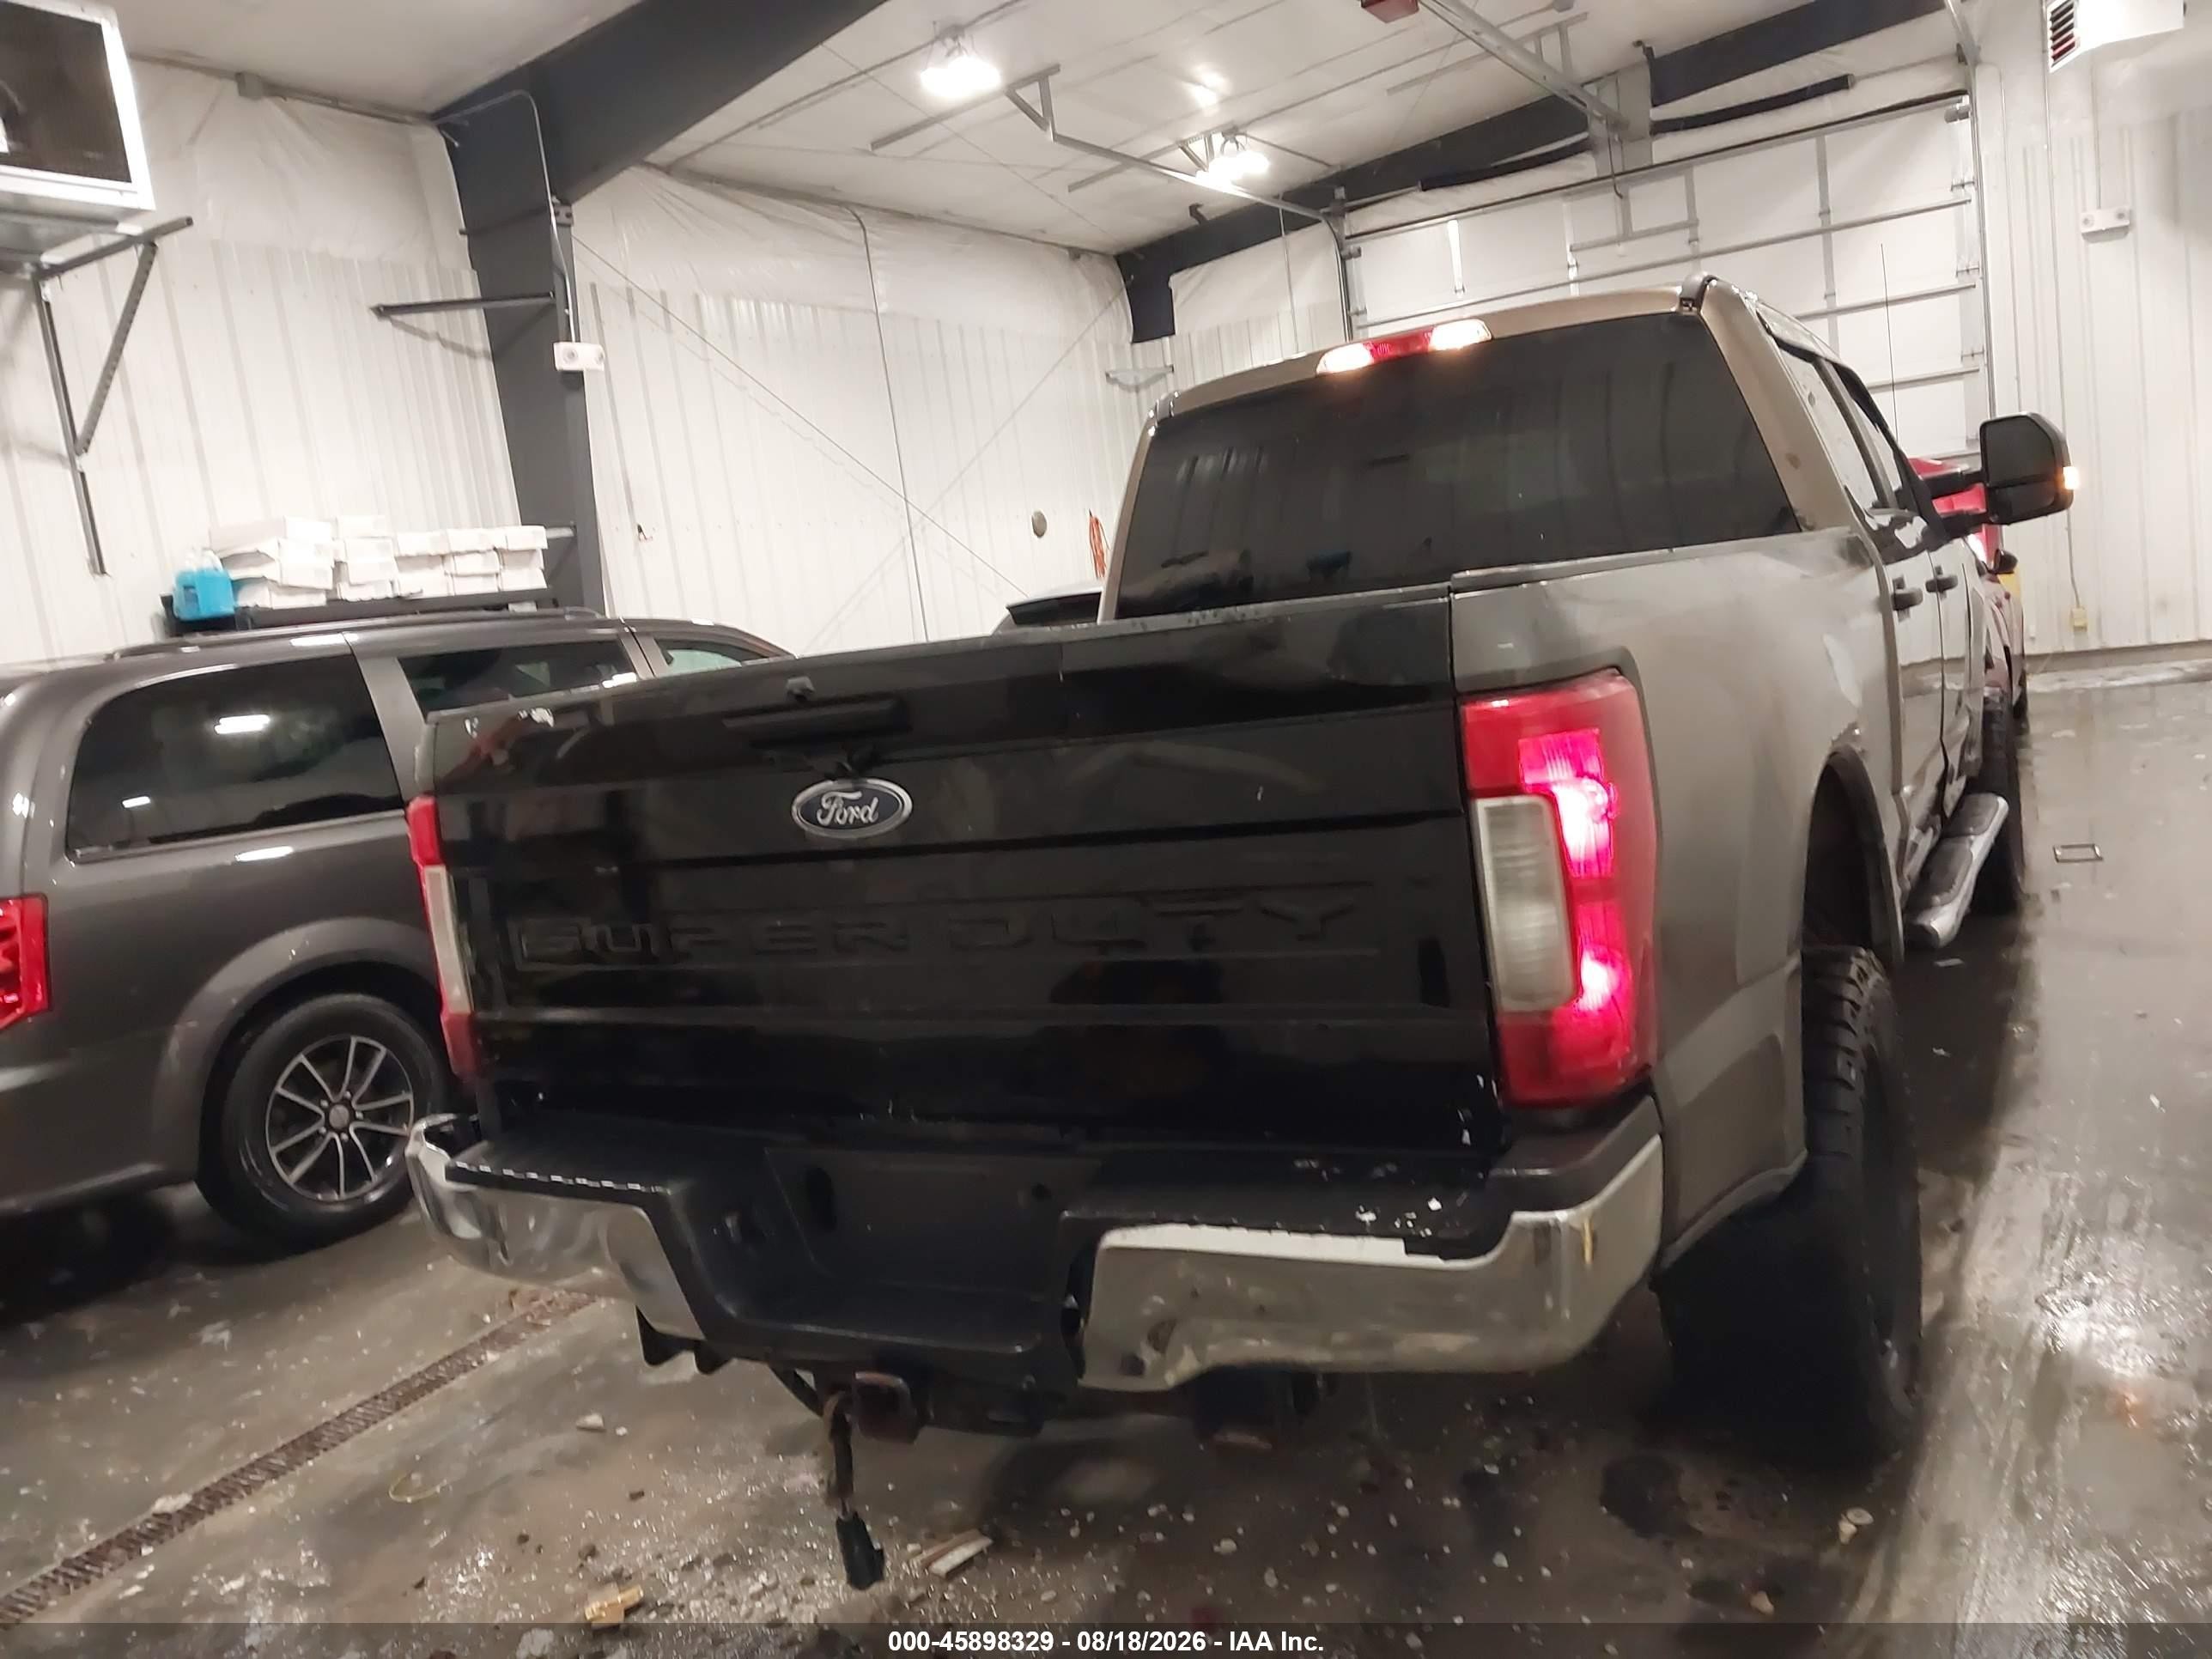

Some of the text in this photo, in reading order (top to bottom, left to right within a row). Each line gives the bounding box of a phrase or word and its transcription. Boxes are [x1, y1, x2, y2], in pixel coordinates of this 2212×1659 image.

[816, 791, 879, 826] Ford
[519, 896, 1358, 963] SUPER DUTY
